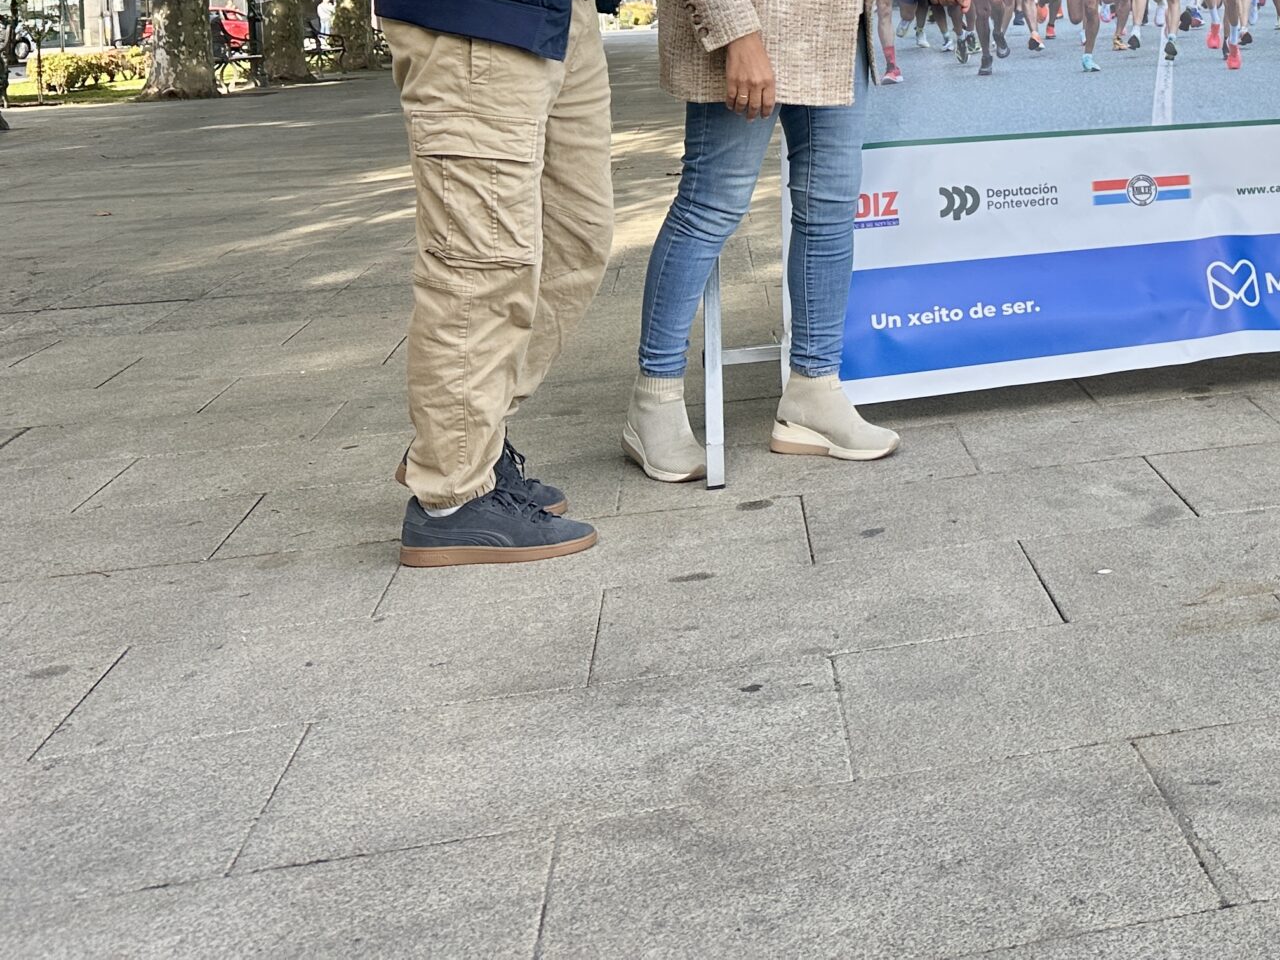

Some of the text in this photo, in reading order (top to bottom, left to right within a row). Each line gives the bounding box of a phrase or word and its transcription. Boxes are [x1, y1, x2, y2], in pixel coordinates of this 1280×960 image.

[986, 183, 1058, 200] Deputación
[986, 196, 1059, 210] Pontevedra
[871, 299, 1041, 330] Un xeito de ser.
